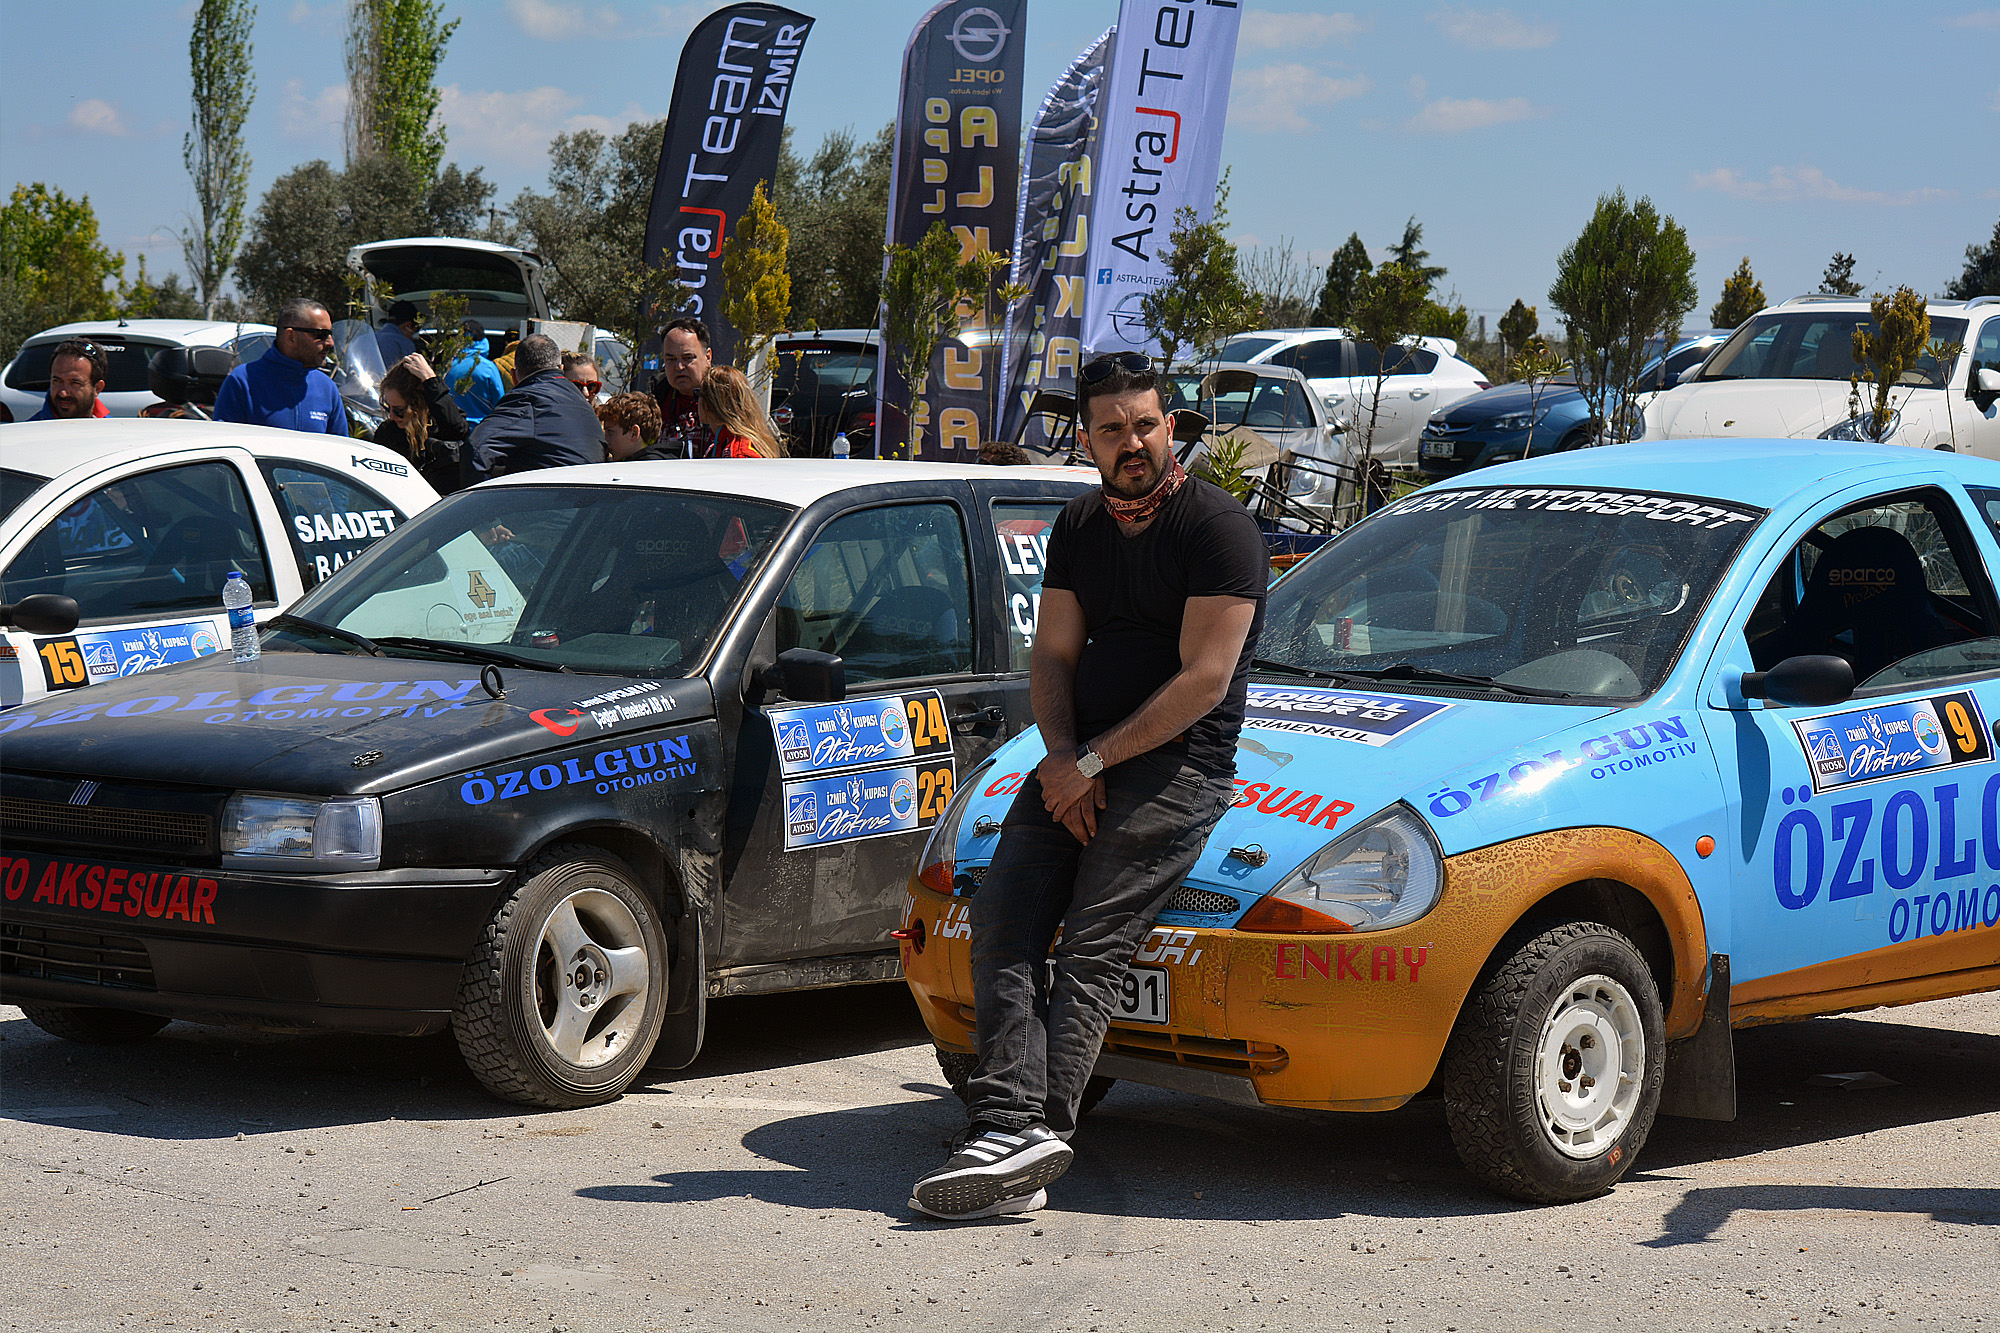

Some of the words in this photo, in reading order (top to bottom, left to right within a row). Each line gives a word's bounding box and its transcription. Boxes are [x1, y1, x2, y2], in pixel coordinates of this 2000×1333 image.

[1138, 0, 1195, 96] Te
[751, 23, 808, 116] İZMİR
[671, 205, 727, 325] straJ
[294, 509, 396, 543] SAADET
[997, 534, 1050, 575] LEV
[1828, 568, 1896, 587] sparco
[39, 640, 87, 685] 15
[123, 639, 145, 652] İZMİR
[161, 636, 190, 649] KUPASI
[91, 664, 116, 675] AYOSK
[647, 696, 664, 714] AB
[815, 718, 837, 733] İZMİR
[852, 714, 879, 729] KUPASI
[907, 697, 948, 748] 24
[1845, 726, 1870, 743] İZMİR
[1883, 719, 1912, 736] KUPASI
[1944, 700, 1978, 754] 9
[786, 749, 809, 761] AYOSK
[812, 729, 886, 767] Otokros
[1427, 715, 1690, 818] ÖZOLGUN
[1590, 741, 1697, 780] OTOMOTİV
[1821, 759, 1845, 773] AYOSK
[1848, 736, 1923, 778] Otokros
[460, 734, 693, 806] ÖZOLGUN
[595, 761, 698, 795] OTOMOTİV
[826, 789, 847, 806] İZMİR
[864, 785, 889, 800] KUPASI
[918, 768, 954, 819] 23
[792, 823, 815, 835] AYOSK
[817, 801, 891, 840] Otokros
[32, 861, 218, 925] AKSESUAR
[611, 880, 647, 919] RALLY
[1276, 943, 1428, 983] ENKAY
[1120, 972, 1159, 1016] 91
[1511, 987, 1549, 1148] PIRELLI
